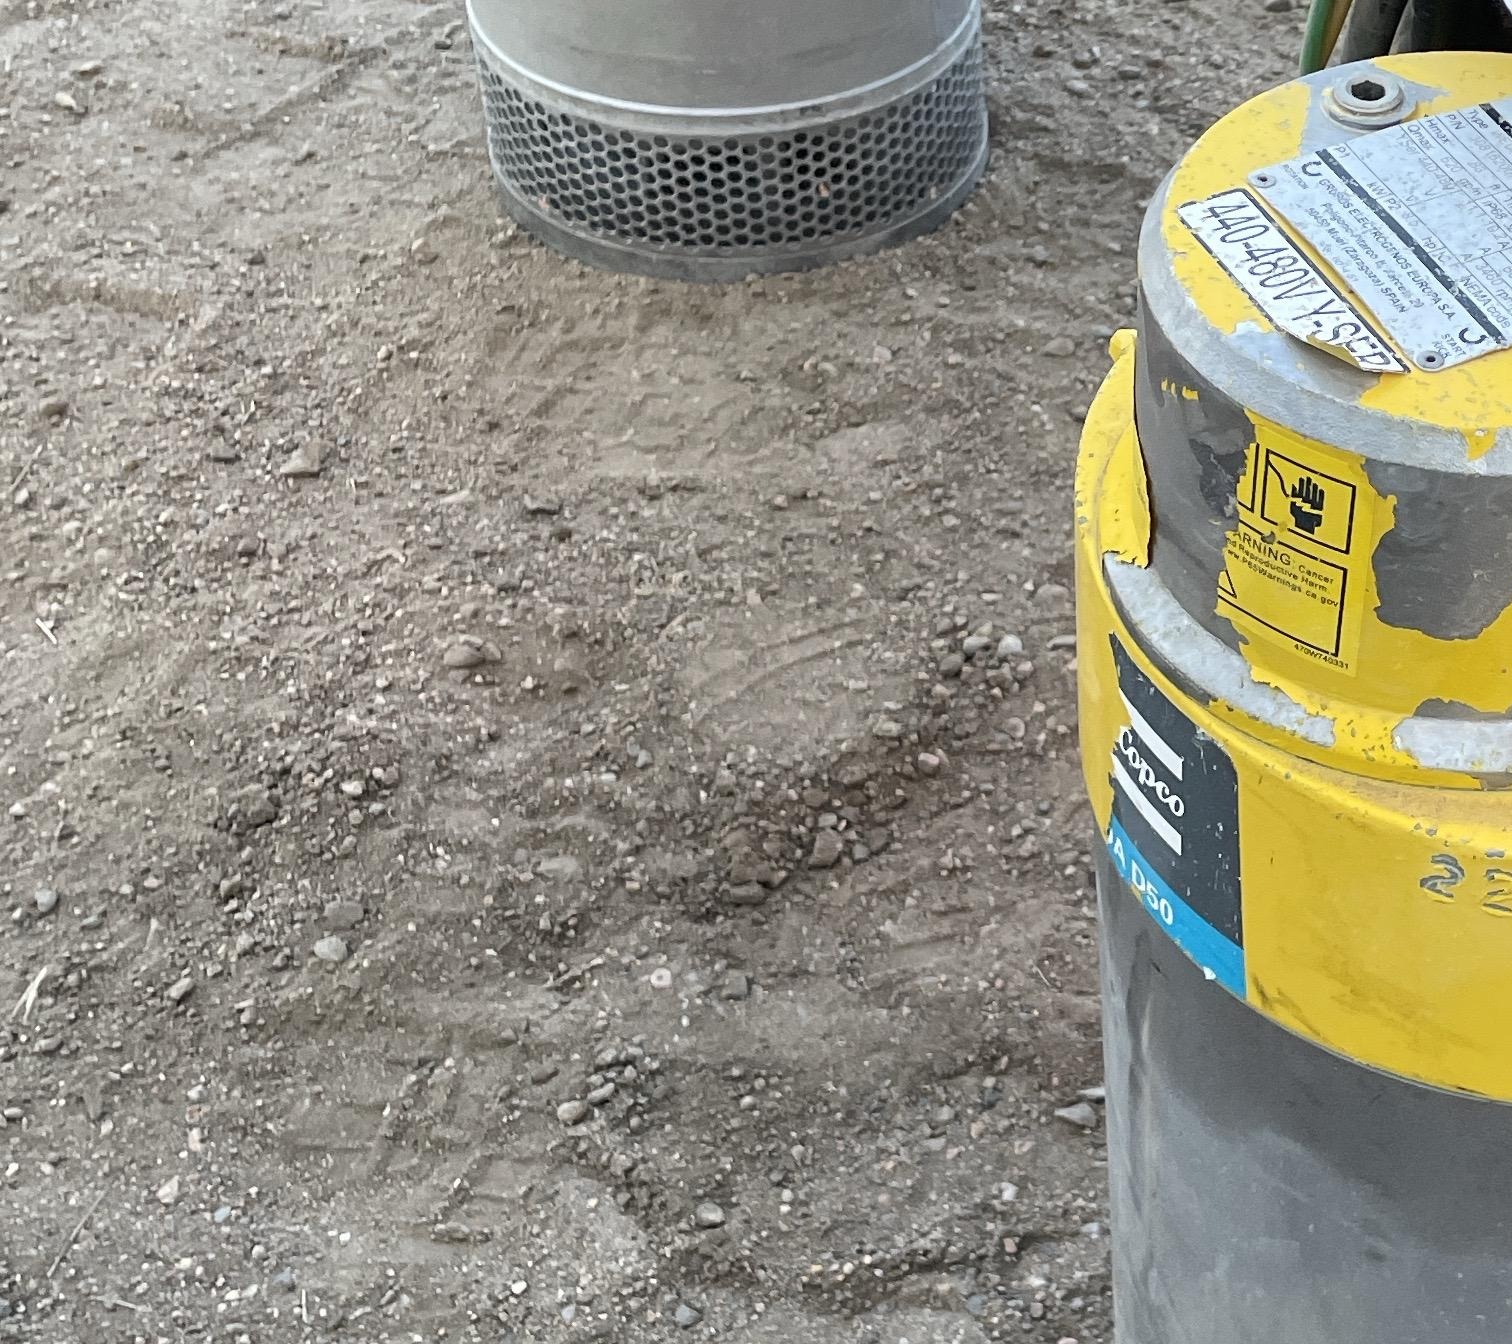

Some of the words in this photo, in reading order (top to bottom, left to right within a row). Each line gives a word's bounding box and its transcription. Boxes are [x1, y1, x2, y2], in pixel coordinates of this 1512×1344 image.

[1423, 119, 1455, 143] Hmax
[1442, 113, 1467, 130] P/N
[1462, 109, 1493, 130] Type
[1404, 124, 1439, 150] Qmax
[1203, 204, 1328, 301] 440-480V
[1378, 286, 1411, 314] SPAIN
[1403, 268, 1445, 304] EUROPA
[1458, 277, 1495, 306] NEMA
[1438, 332, 1468, 357] START
[1238, 543, 1299, 581] Reproductive
[1298, 564, 1334, 585] Cancer
[1119, 730, 1185, 817] Copco
[1131, 860, 1174, 925] D50
